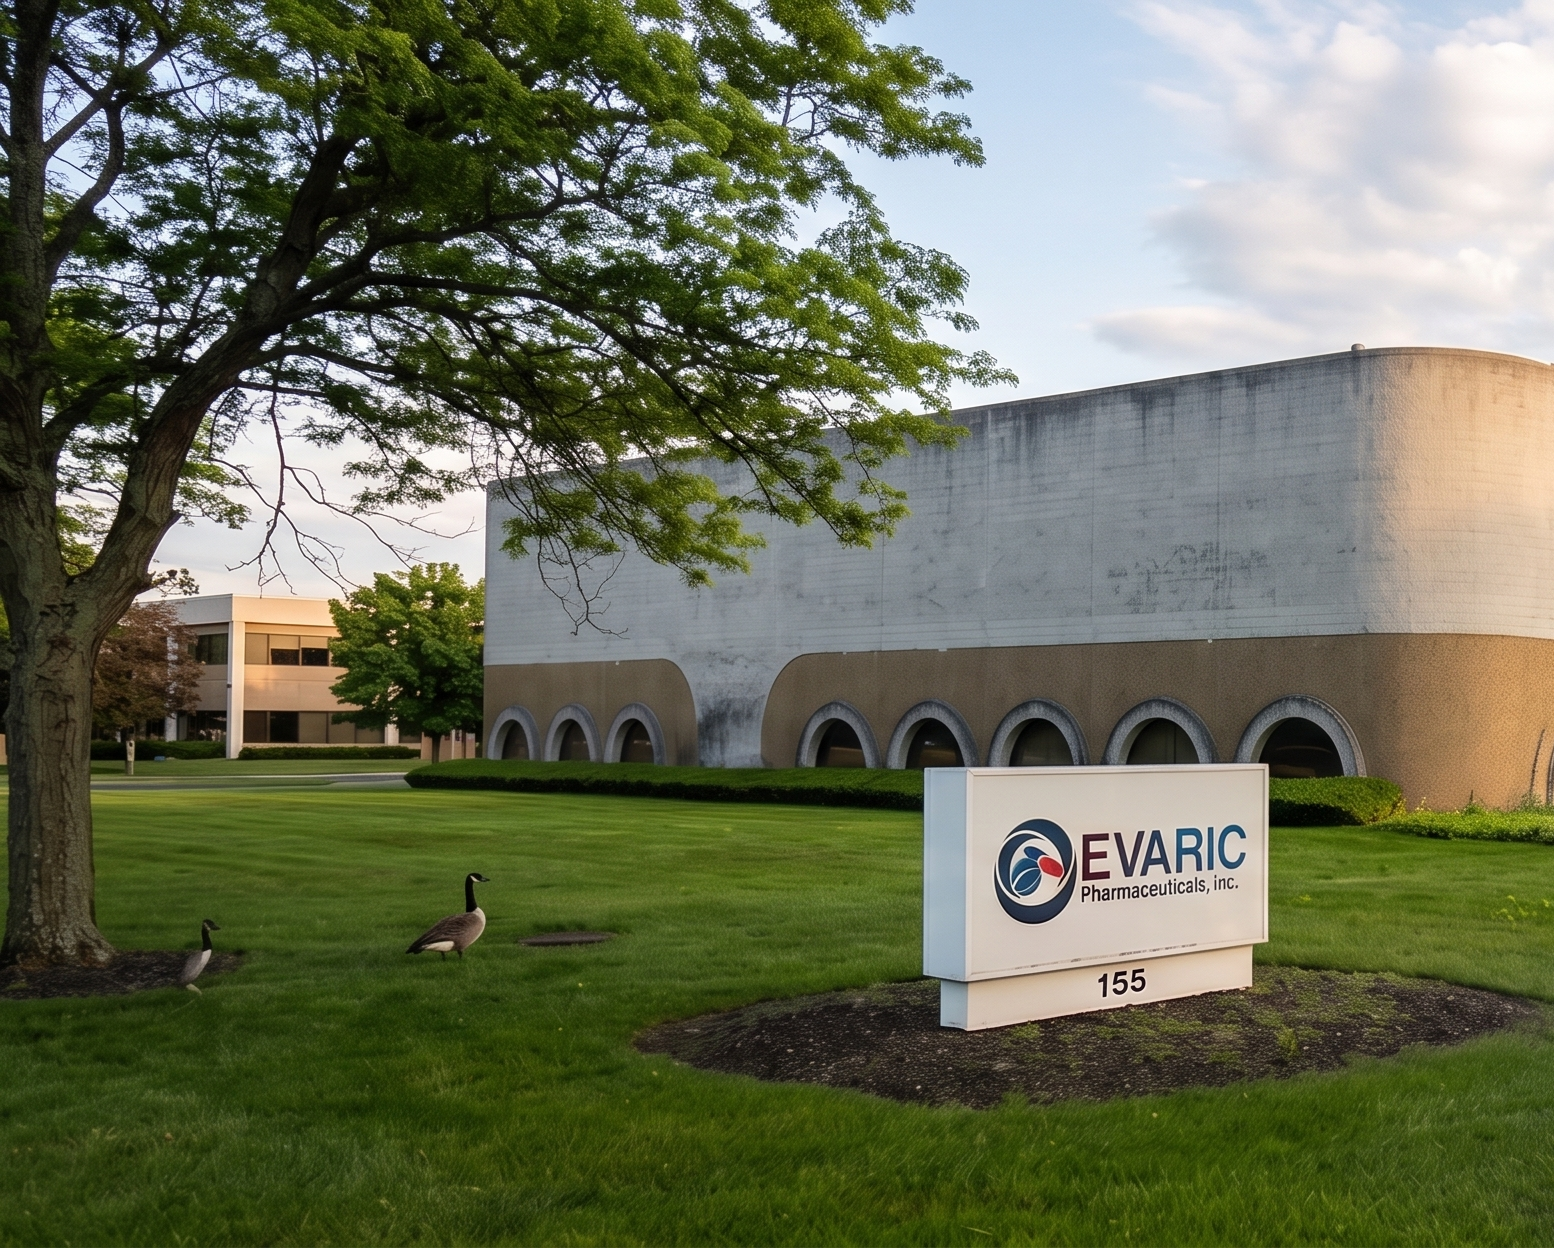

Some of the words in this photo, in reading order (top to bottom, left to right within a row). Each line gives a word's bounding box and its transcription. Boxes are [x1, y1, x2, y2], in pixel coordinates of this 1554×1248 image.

[1081, 824, 1247, 882] EVARIC
[1081, 876, 1211, 903] Pharmaceuticals,
[1213, 874, 1239, 891] inc.
[1097, 968, 1147, 998] 155
